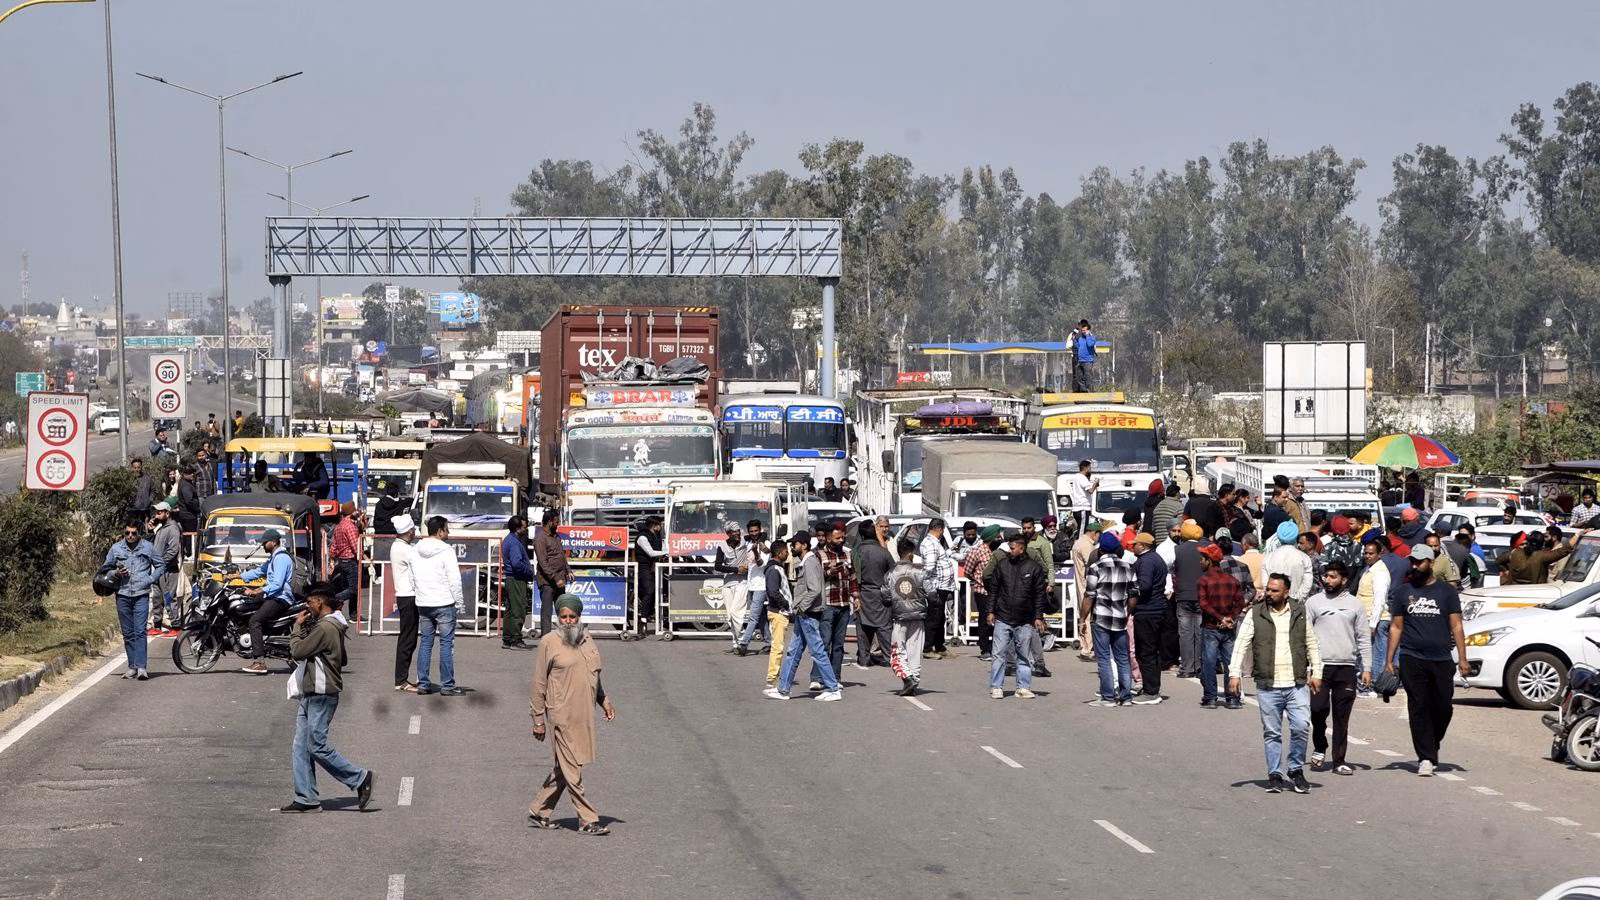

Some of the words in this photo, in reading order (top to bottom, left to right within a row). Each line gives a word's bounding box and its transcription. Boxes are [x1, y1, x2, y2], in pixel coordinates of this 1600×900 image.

[659, 344, 675, 353] TGBU
[681, 345, 704, 354] 577322
[708, 345, 715, 354] 5
[578, 343, 617, 367] tex
[161, 370, 174, 380] 90
[32, 397, 61, 405] SPEED
[62, 397, 85, 406] LIMIT
[612, 389, 673, 404] BRAR
[161, 400, 174, 409] 65
[588, 415, 614, 425] GOODS
[940, 416, 978, 427] JDL
[1059, 416, 1092, 426] ਪੰਜਾਬ
[46, 466, 65, 480] 65
[569, 530, 593, 538] STOP
[571, 539, 606, 547] CHECKING
[672, 536, 701, 552] ਪੁਲਿਸ
